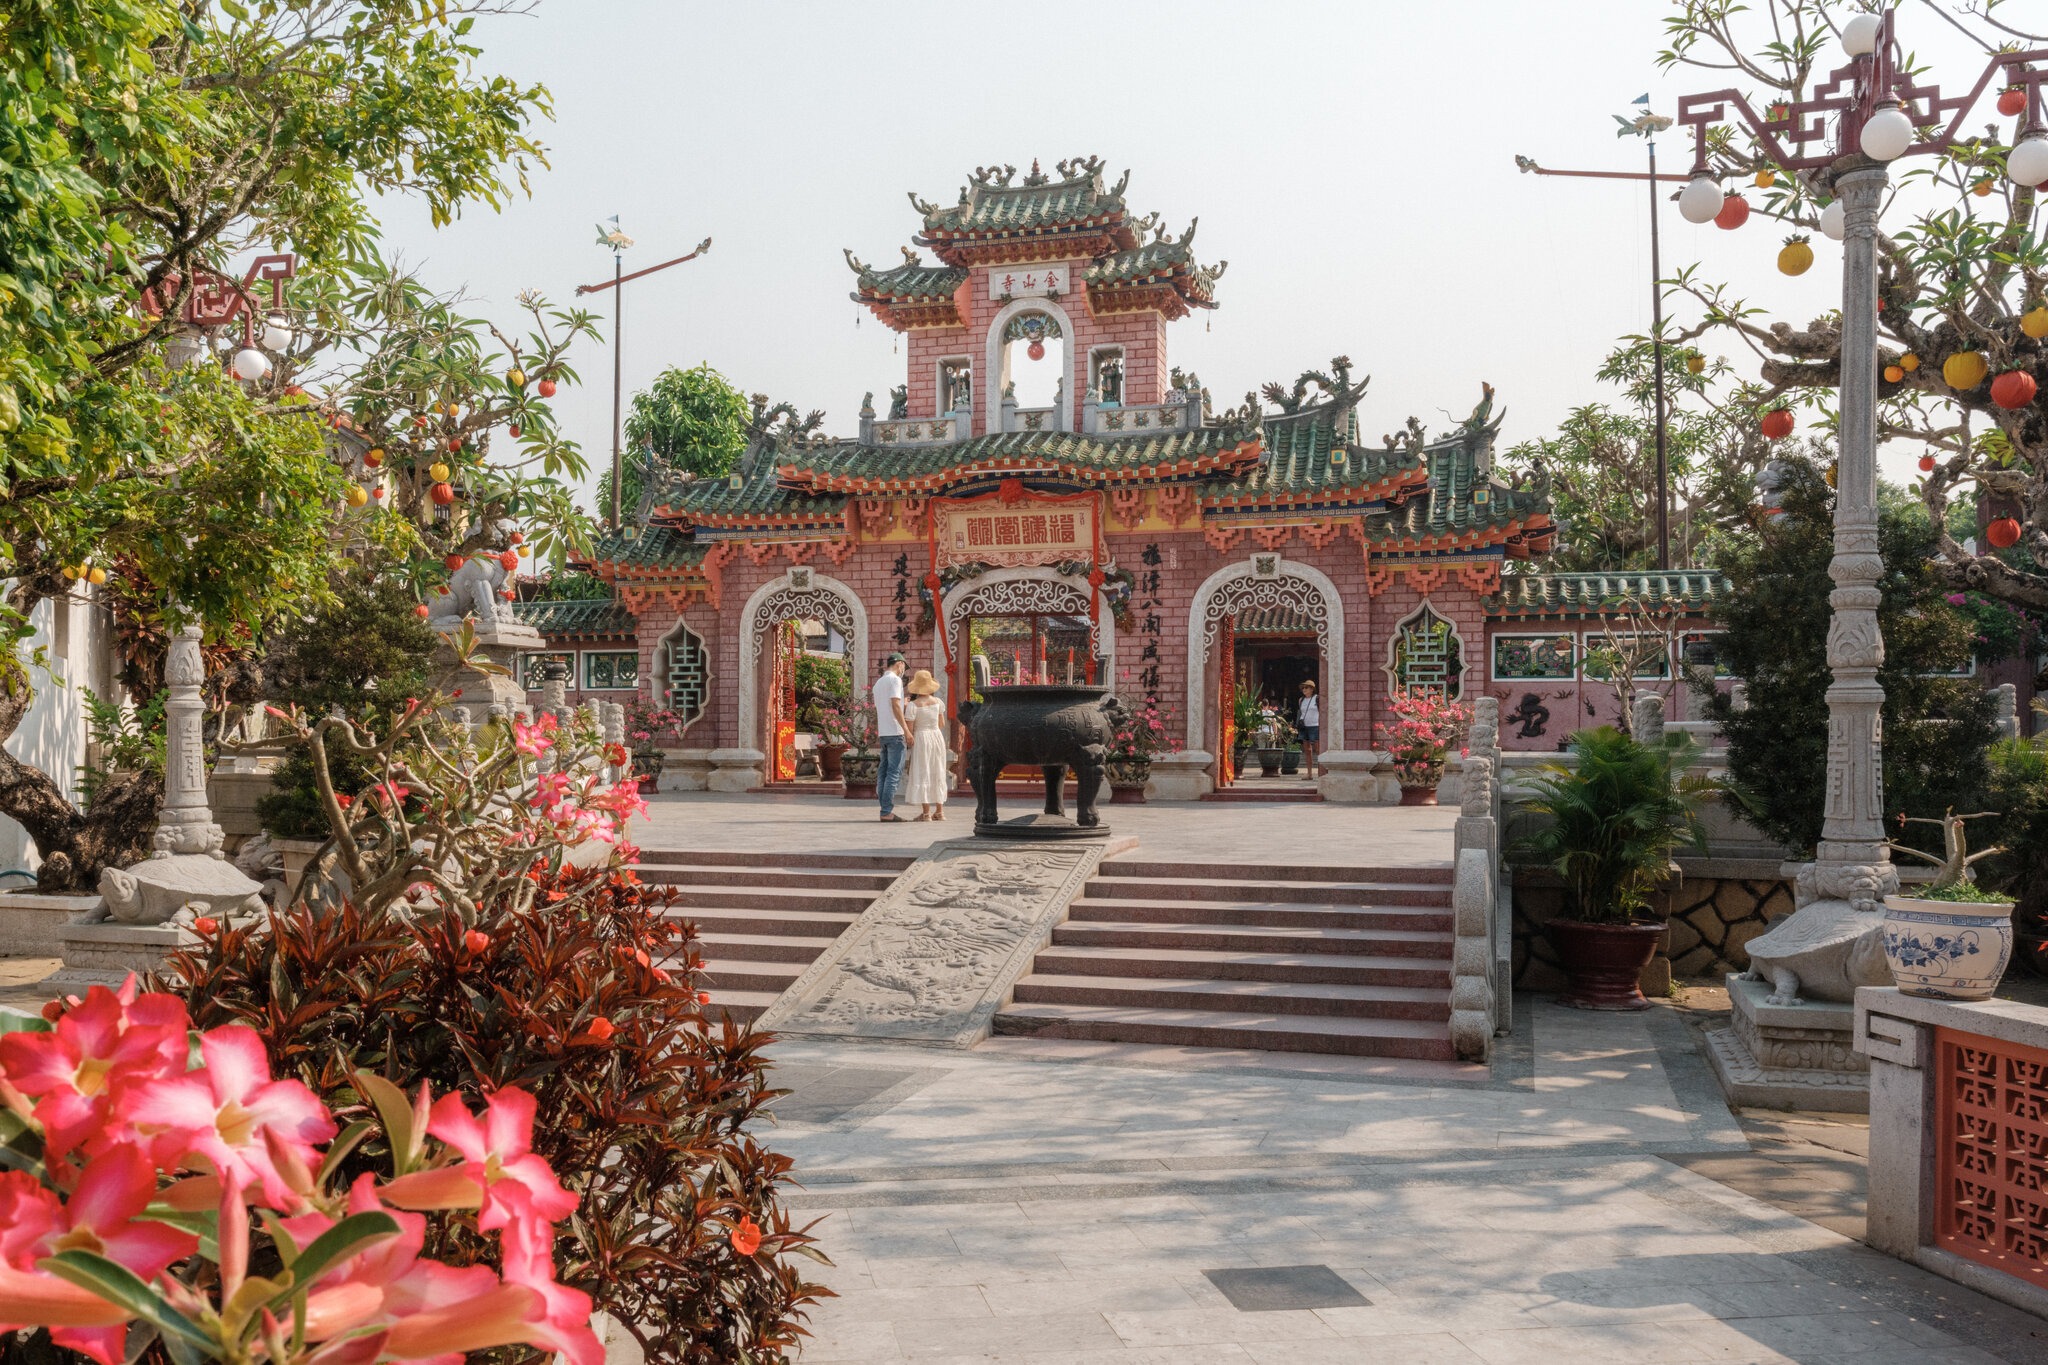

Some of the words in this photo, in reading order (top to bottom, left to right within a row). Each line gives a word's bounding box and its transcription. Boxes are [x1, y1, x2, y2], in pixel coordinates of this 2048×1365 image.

[1001, 270, 1060, 292] 金山寺
[966, 513, 1076, 546] 福建會館
